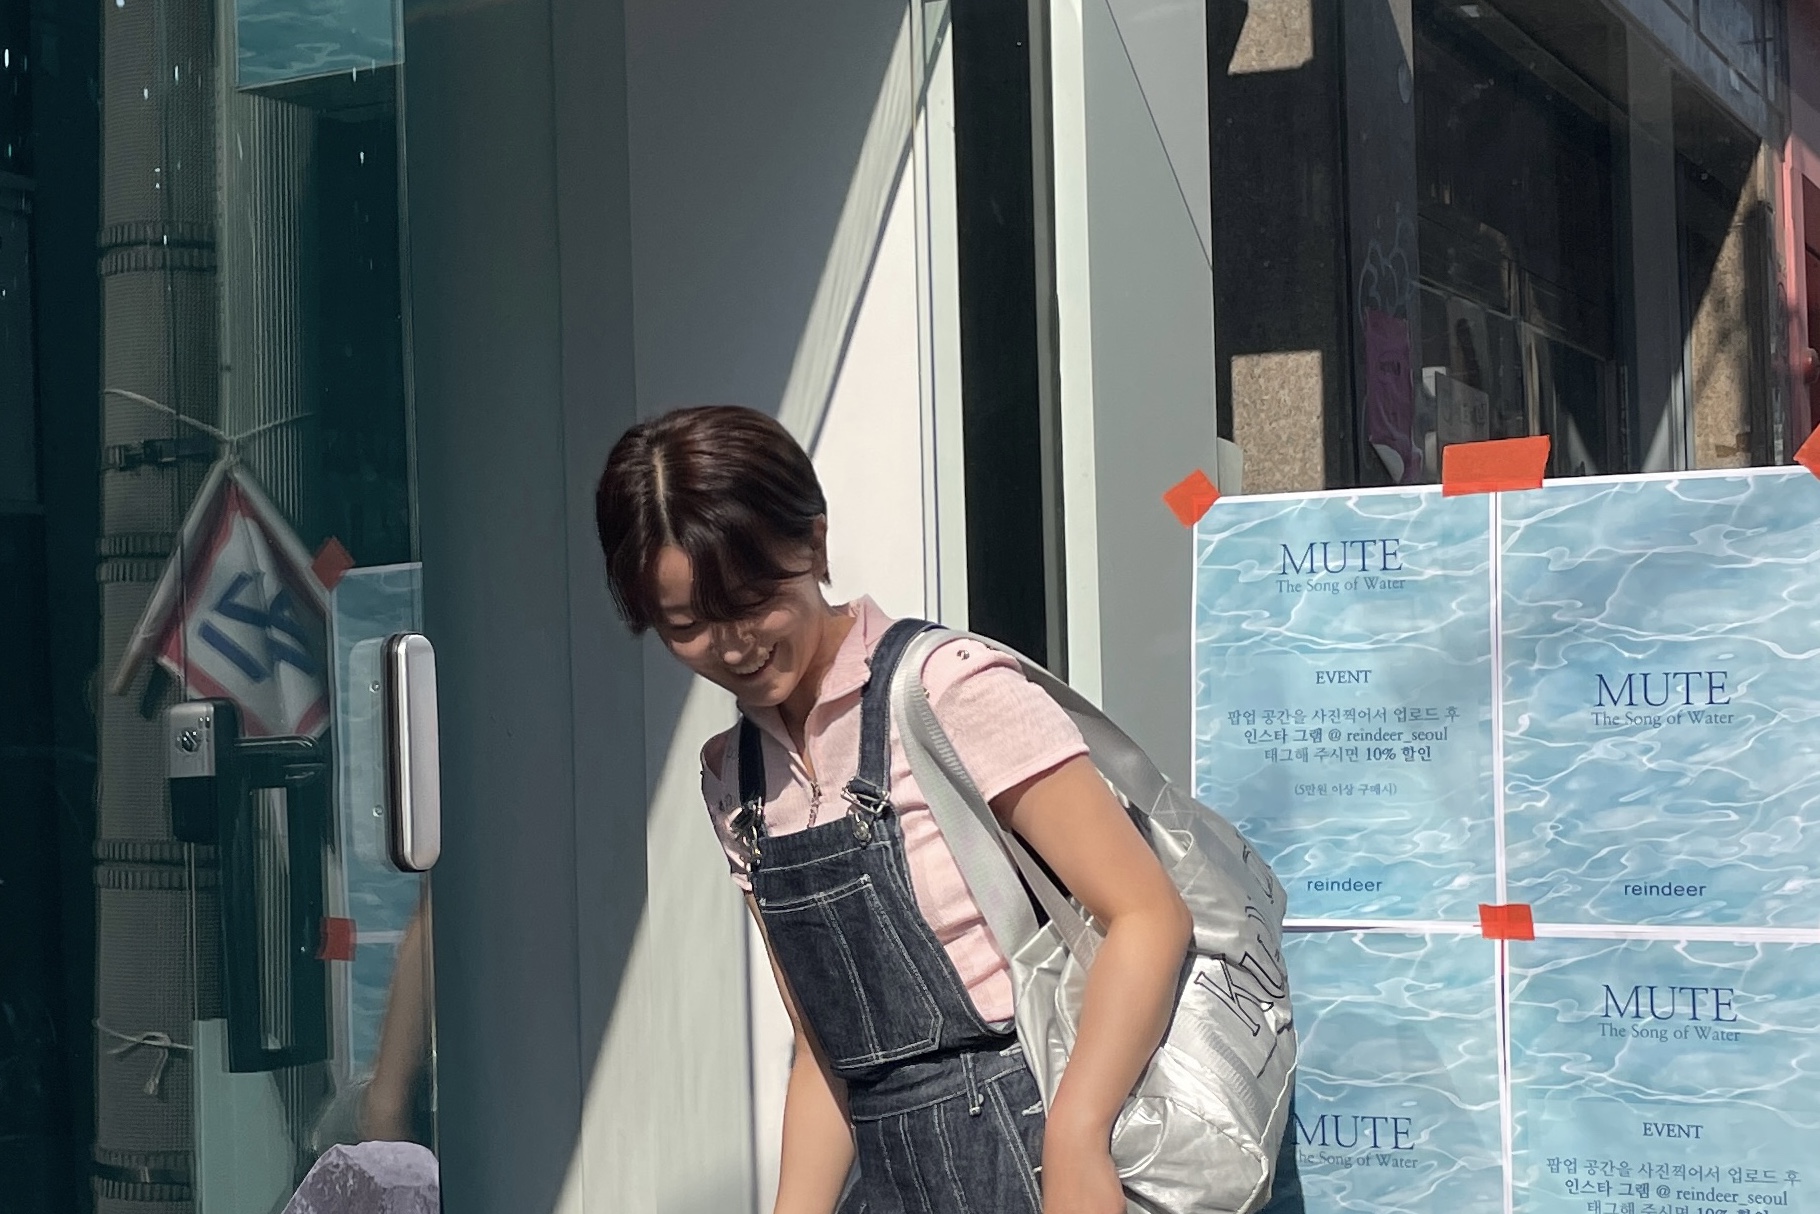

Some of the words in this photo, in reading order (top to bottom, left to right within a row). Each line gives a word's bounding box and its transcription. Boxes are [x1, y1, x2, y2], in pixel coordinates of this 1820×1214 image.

[1278, 538, 1403, 575] MUTE
[1276, 579, 1302, 593] The
[1307, 578, 1340, 595] Song
[1345, 576, 1360, 590] of
[1364, 576, 1406, 590] Water
[1315, 669, 1372, 684] EVENT
[1594, 671, 1732, 707] MUTE
[1228, 709, 1256, 726] 팝업
[1262, 708, 1306, 725] 공간을
[1311, 706, 1387, 724] 사진찍어서
[1393, 706, 1440, 723] 업로드
[1444, 706, 1460, 723] 후
[1591, 711, 1620, 726] The
[1625, 711, 1662, 728] Song
[1667, 710, 1684, 724] of
[1687, 710, 1734, 724] Water
[1244, 728, 1288, 744] 인스타
[1328, 728, 1342, 742] @
[1347, 727, 1448, 745] reindeer_seoul
[1264, 747, 1309, 763] 태그해
[1314, 747, 1359, 763] 주시면
[1366, 747, 1396, 761] 10%
[1401, 746, 1432, 763] 할인
[1332, 783, 1354, 796] 이상
[1307, 878, 1382, 891] reindeer
[1625, 881, 1707, 896] reindeer
[1600, 984, 1738, 1022] MUTE
[1598, 1022, 1626, 1038] The
[1632, 1023, 1668, 1043] Song
[1674, 1025, 1690, 1040] of
[1693, 1026, 1741, 1042] Water
[1289, 1112, 1415, 1150] MUTE
[1643, 1122, 1704, 1139] EVENT
[1319, 1151, 1352, 1168] Song
[1357, 1152, 1372, 1166] of
[1375, 1153, 1418, 1168] Water
[1546, 1157, 1577, 1175] 팝업
[1583, 1159, 1633, 1178] 공간을
[1638, 1162, 1720, 1183] 사진찍어서
[1728, 1166, 1778, 1184] 업로드
[1784, 1168, 1801, 1186] 후
[1565, 1178, 1613, 1198] 인스타
[1618, 1182, 1650, 1199] 그램
[1656, 1184, 1671, 1198] @
[1676, 1187, 1788, 1207] reindeer_seoul
